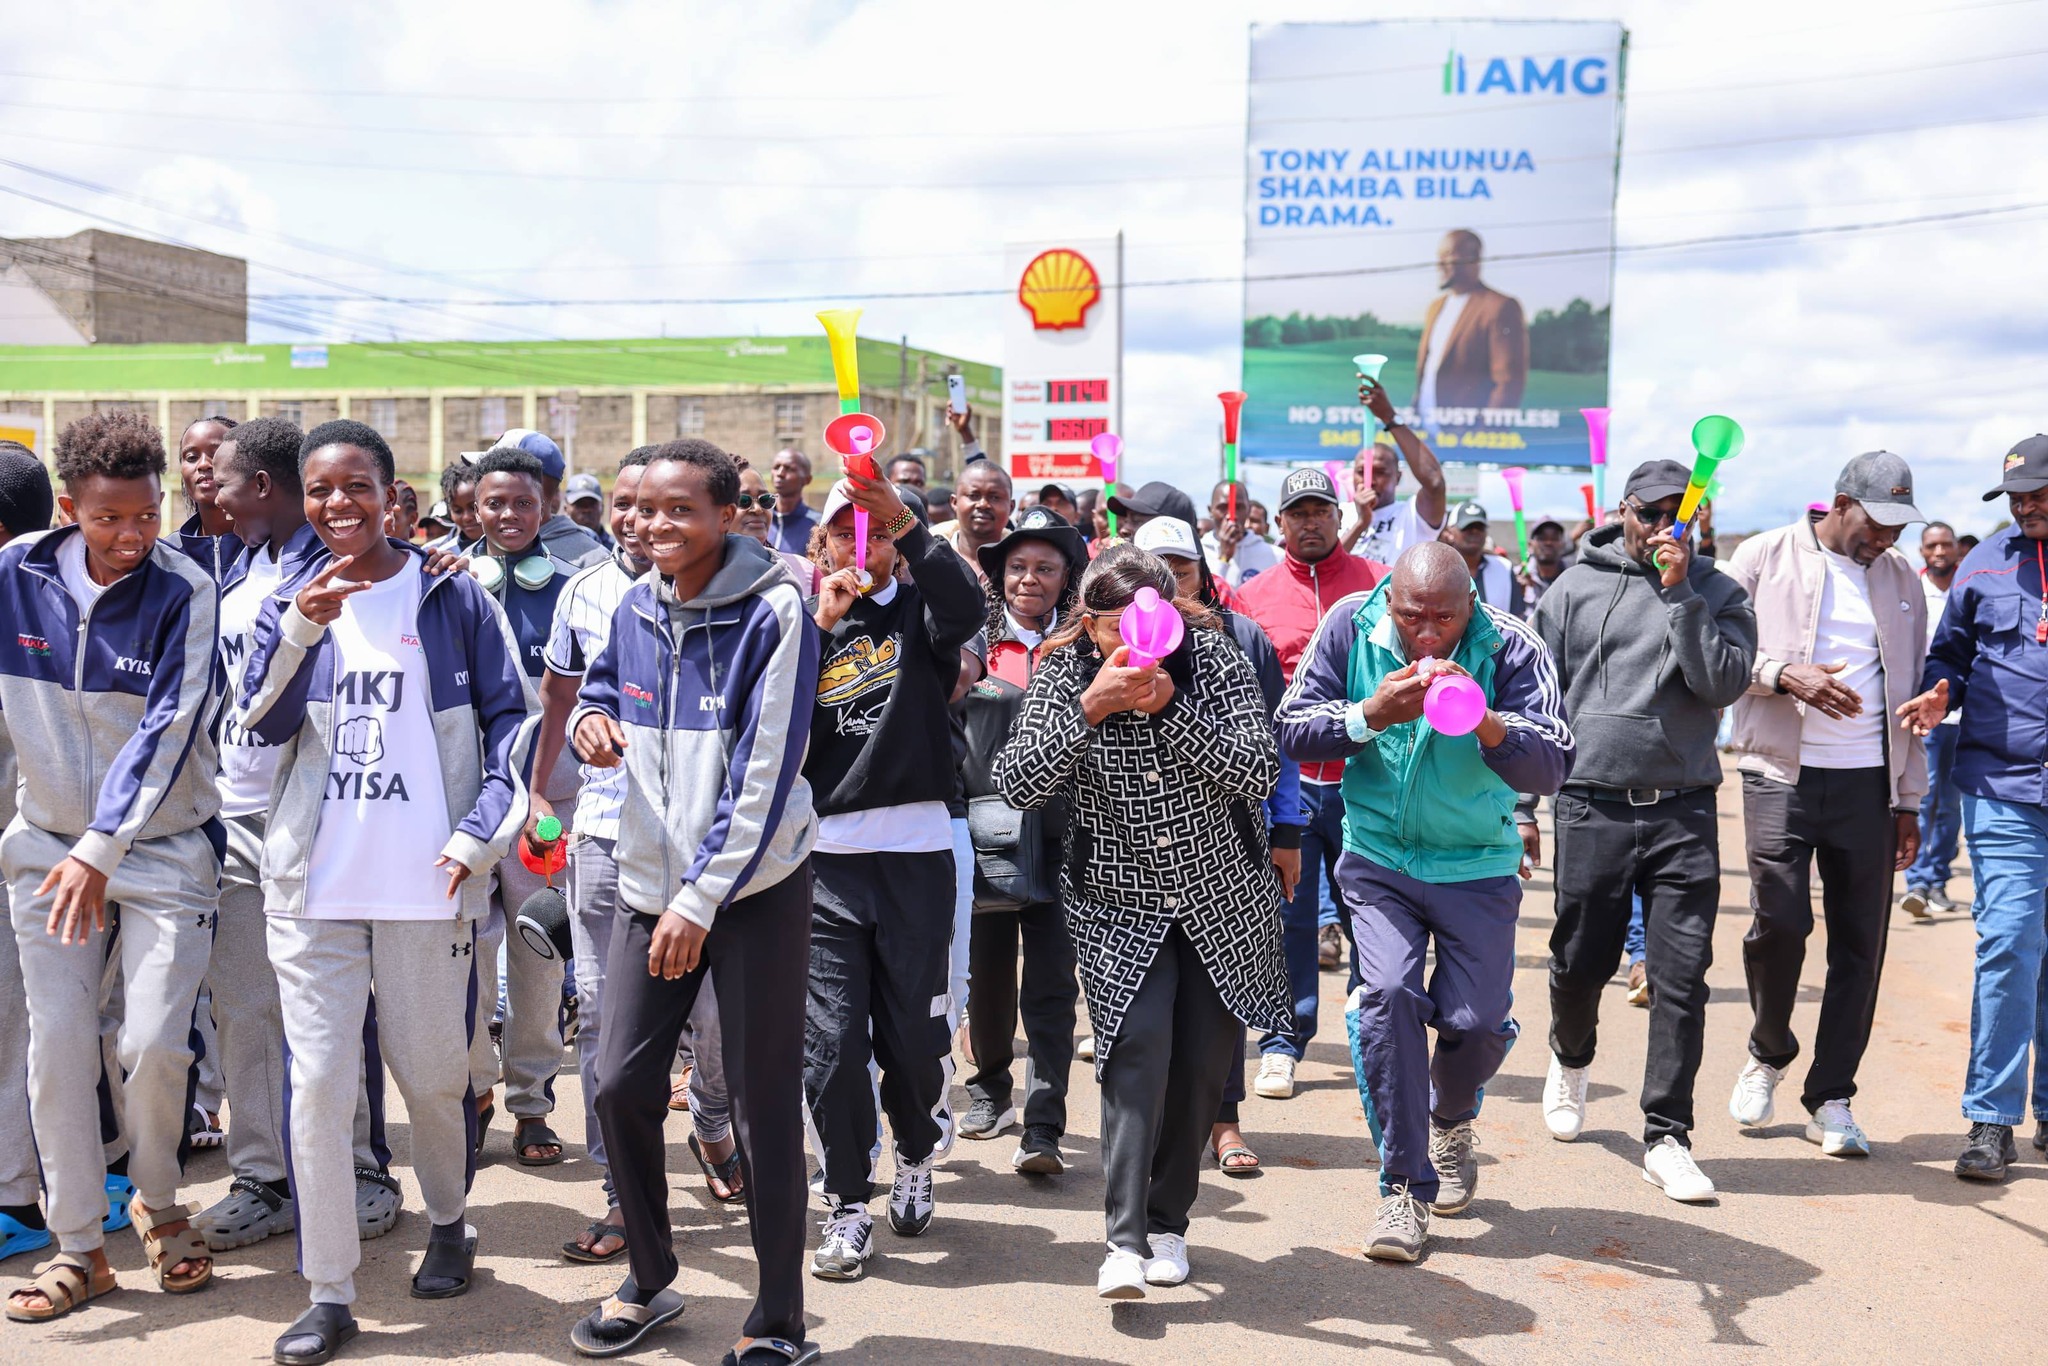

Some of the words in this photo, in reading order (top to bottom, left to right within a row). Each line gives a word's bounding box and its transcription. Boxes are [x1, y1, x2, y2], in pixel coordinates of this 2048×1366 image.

[1477, 57, 1606, 95] AMG
[1260, 150, 1349, 171] TONY
[1361, 150, 1534, 172] ALINUNUA
[1259, 177, 1403, 199] SHAMBA
[1415, 178, 1491, 199] BILA
[1260, 205, 1392, 226] DRAMA.
[1288, 406, 1323, 424] NO
[1426, 407, 1479, 425] JUST
[1480, 408, 1560, 428] TITLES!
[1320, 431, 1361, 446] SMS
[1436, 432, 1458, 447] to
[530, 645, 548, 656] KY
[114, 656, 152, 675] KYIS
